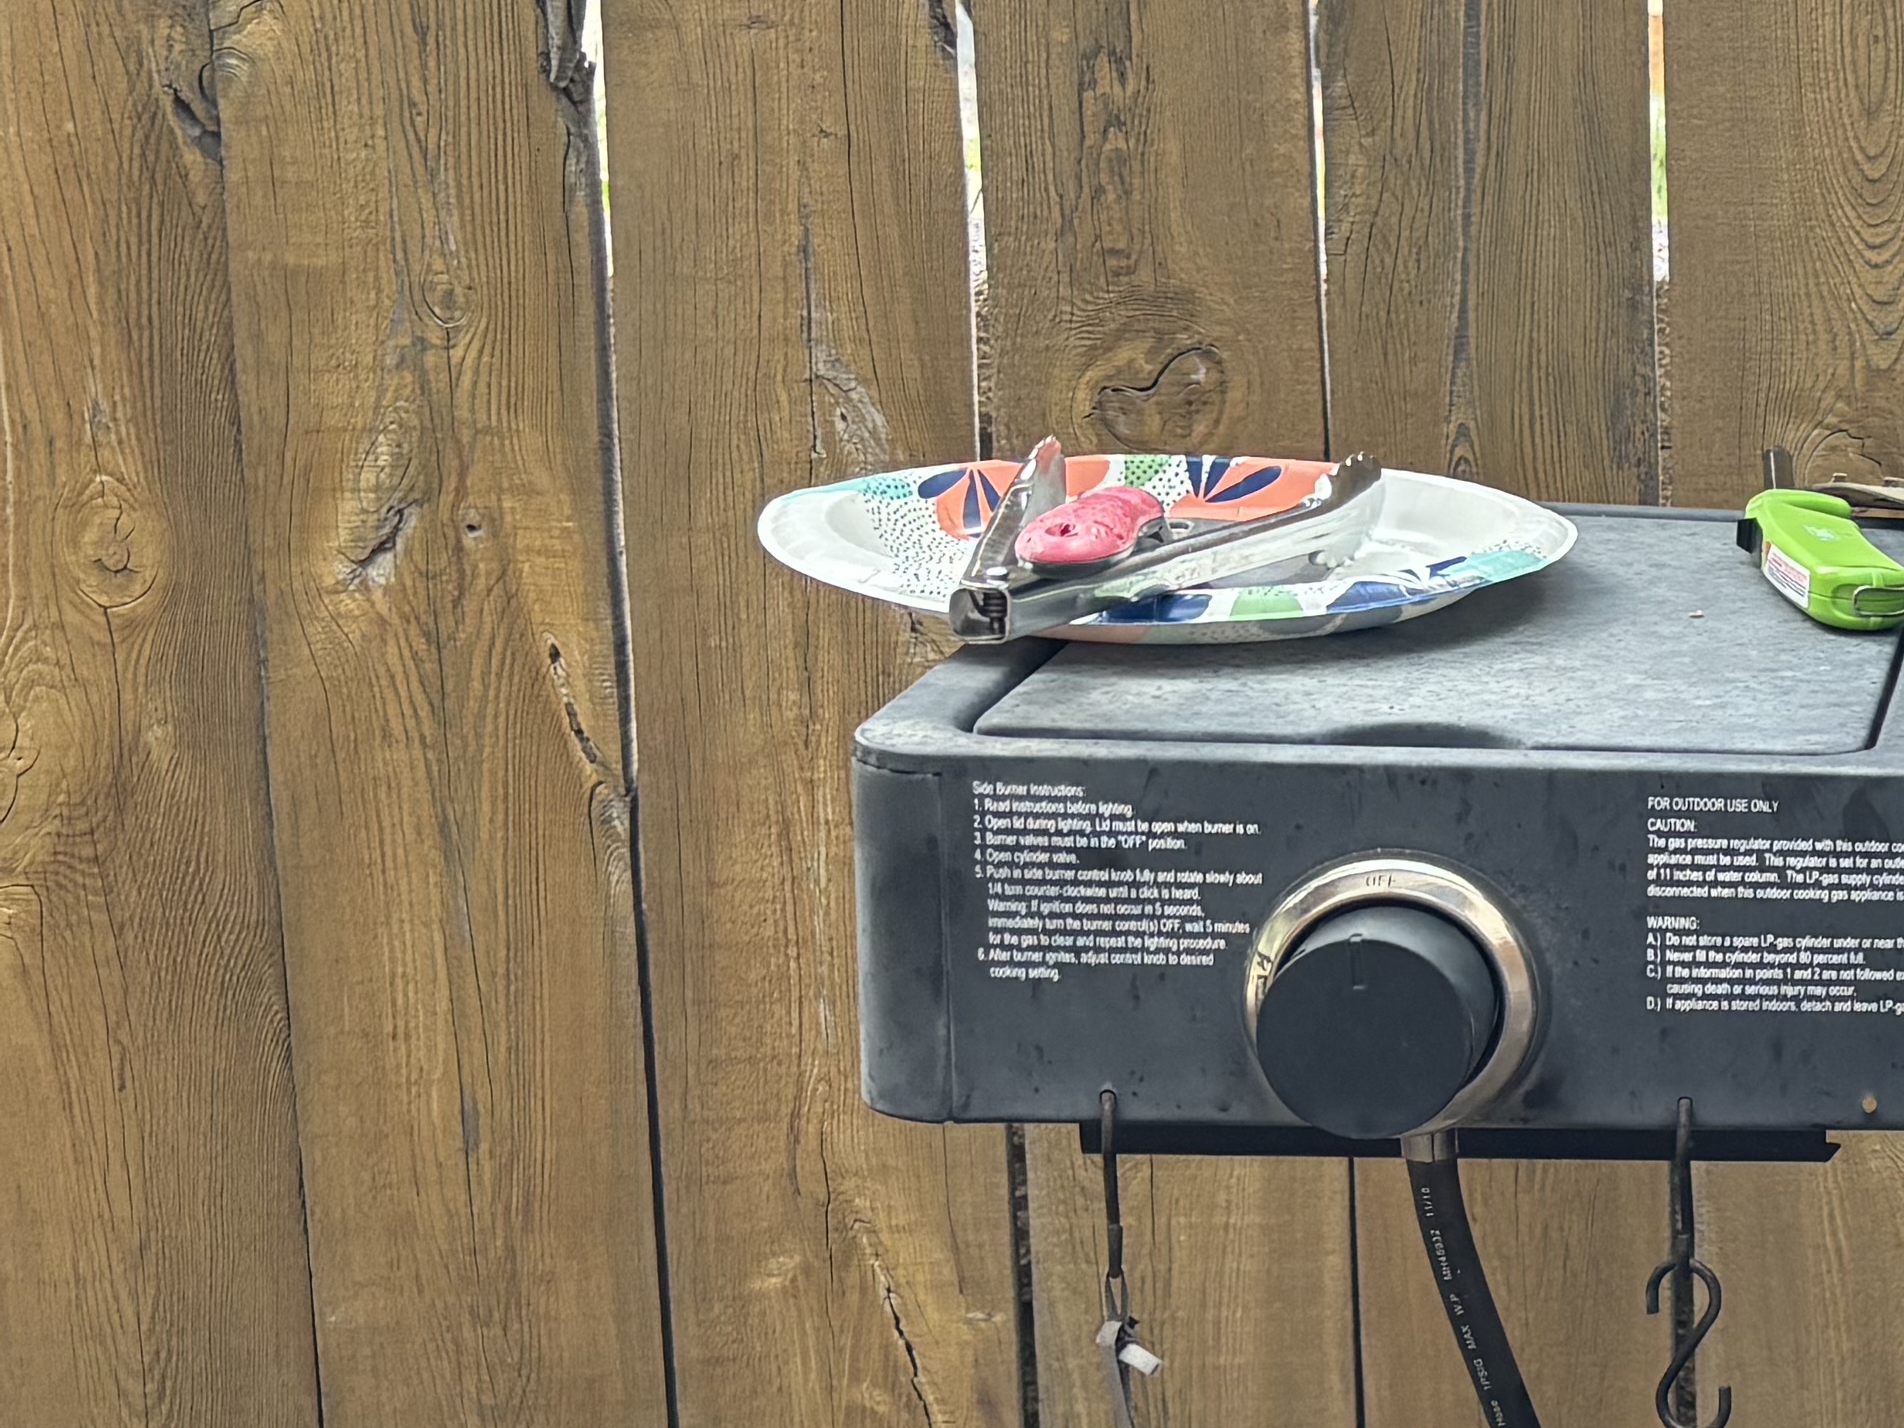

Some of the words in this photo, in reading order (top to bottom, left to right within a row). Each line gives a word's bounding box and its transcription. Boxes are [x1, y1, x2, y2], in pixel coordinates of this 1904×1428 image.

[973, 781, 993, 793] Side
[995, 781, 1027, 794] Burner
[1029, 782, 1086, 796] Instructions:
[984, 799, 1010, 811] Read
[1011, 799, 1064, 812] instructions
[1066, 800, 1096, 813] before
[1648, 797, 1670, 810] FOR
[1672, 797, 1724, 811] OUTDOOR
[1726, 799, 1747, 812] USE
[1750, 799, 1779, 812] ONLY
[1647, 818, 1697, 832] CAUTION:
[1647, 835, 1665, 848] The
[1667, 838, 1685, 852] gas
[1687, 838, 1727, 853] pressure
[1729, 836, 1770, 853] regulator
[1772, 837, 1812, 854] provided
[1814, 838, 1833, 851] with
[1835, 838, 1852, 851] this
[1854, 839, 1888, 852] outdoor
[985, 848, 1011, 865] Open
[1013, 849, 1049, 866] cylinder
[1647, 851, 1692, 868] appliance
[1693, 852, 1717, 865] must
[1719, 852, 1731, 865] be
[1765, 853, 1783, 866] This
[1785, 854, 1826, 871] regulator
[1828, 854, 1836, 867] is
[1839, 855, 1853, 868] set
[1855, 855, 1867, 868] for
[1870, 858, 1882, 868] an
[1647, 867, 1656, 880] of
[1660, 867, 1670, 880] 11
[1673, 868, 1703, 881] inches
[1705, 868, 1714, 881] of
[1716, 868, 1742, 882] water
[1787, 870, 1804, 883] The
[1805, 870, 1838, 887] LP-gas
[1840, 871, 1870, 888] supply
[1647, 884, 1708, 898] disconnected
[1710, 885, 1735, 898] when
[1737, 885, 1753, 898] this
[1756, 886, 1790, 899] outdoor
[1793, 886, 1829, 903] cooking
[1830, 889, 1847, 903] gas
[1850, 887, 1894, 904] appliance
[1896, 888, 1904, 901] is
[1646, 916, 1700, 930] WARNING:
[1461, 1325, 1477, 1350] MAX
[1490, 1400, 1505, 1426] Hose
